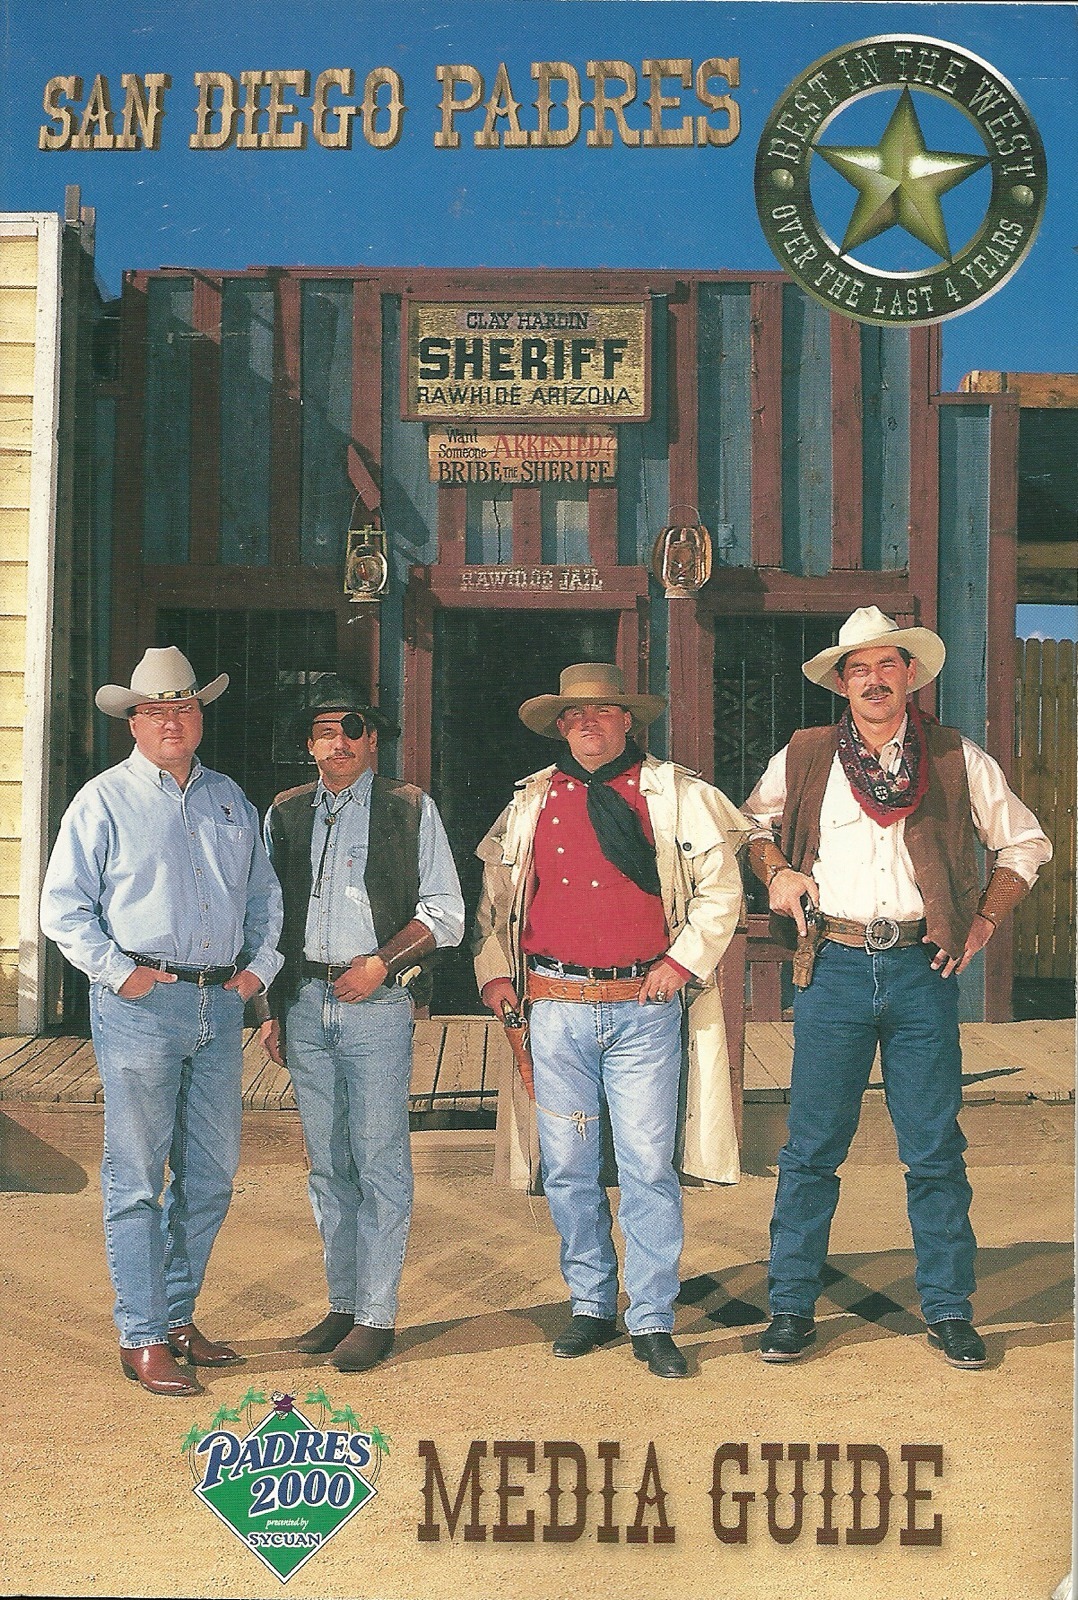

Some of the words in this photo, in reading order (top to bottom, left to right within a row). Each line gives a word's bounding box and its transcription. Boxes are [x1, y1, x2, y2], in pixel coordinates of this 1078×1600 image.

[466, 312, 513, 330] CLAY
[517, 312, 589, 330] HARDIN
[419, 337, 628, 380] SHERIFF
[416, 386, 522, 405] RAWHIDE
[530, 386, 634, 405] ARIZONA
[445, 428, 478, 444] Want
[438, 444, 488, 459] Someone
[438, 461, 501, 483] BRIBE
[521, 460, 610, 483] SHERIFF
